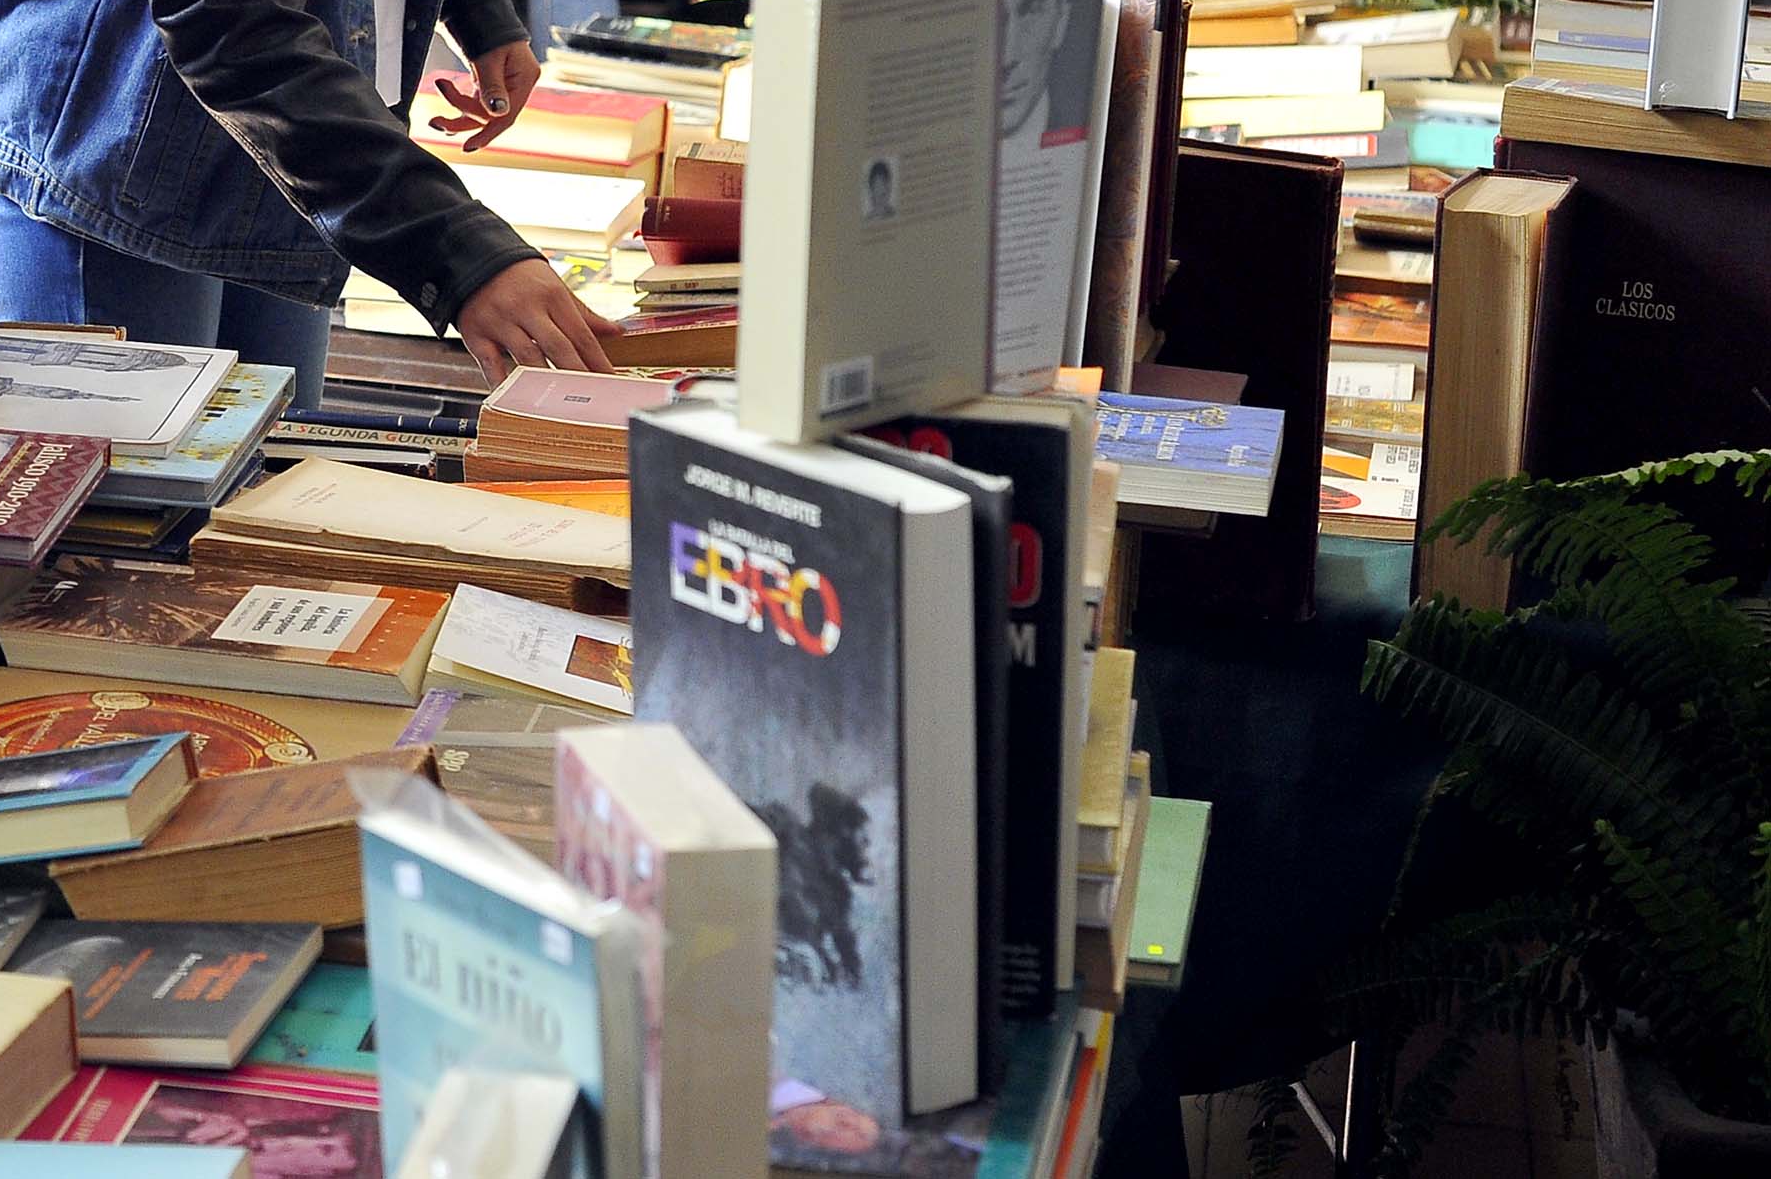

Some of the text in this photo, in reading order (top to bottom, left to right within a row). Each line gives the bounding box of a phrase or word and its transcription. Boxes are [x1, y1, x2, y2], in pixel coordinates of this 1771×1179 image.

[1622, 281, 1653, 299] LOS
[1596, 298, 1676, 321] CLASICOS
[298, 425, 380, 441] SEGUNDA
[386, 433, 459, 447] GUERRA
[25, 441, 74, 476] Jalisco
[670, 521, 842, 656] EBRO
[403, 927, 563, 1053] El niño
